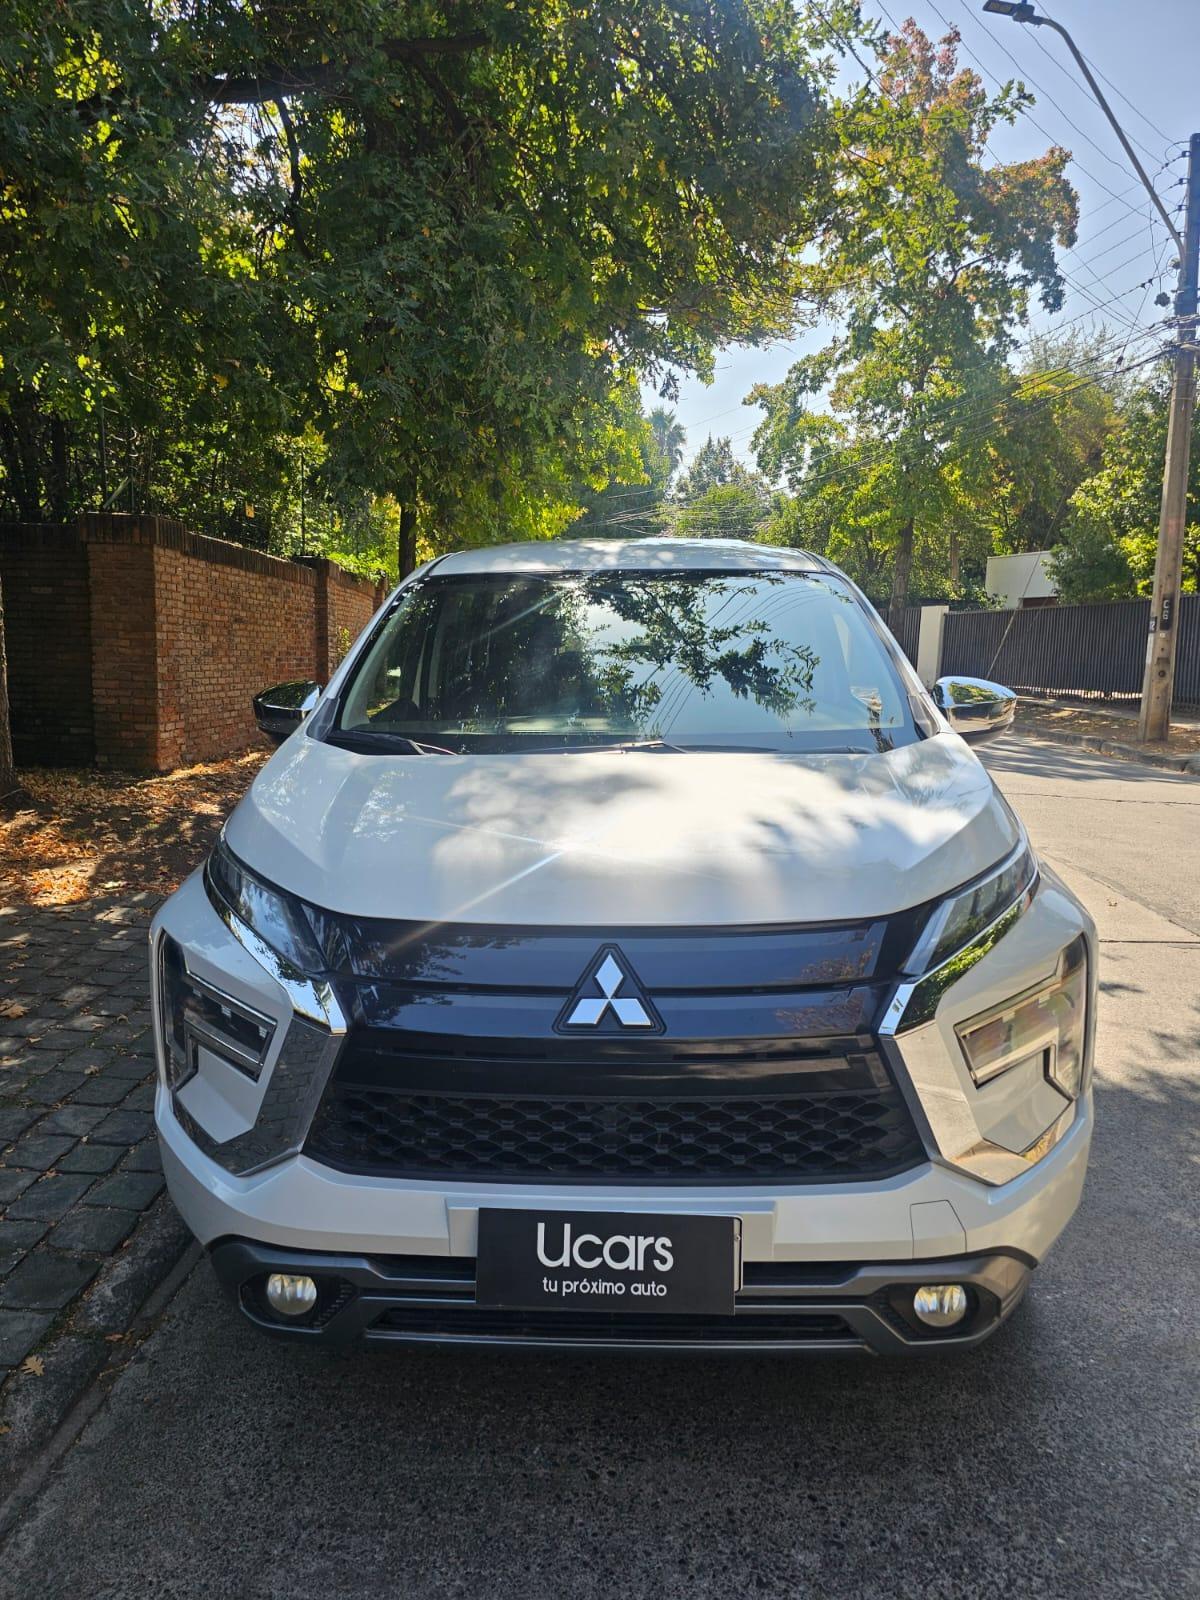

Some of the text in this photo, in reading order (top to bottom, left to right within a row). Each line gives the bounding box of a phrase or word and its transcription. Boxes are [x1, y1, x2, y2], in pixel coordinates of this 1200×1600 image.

[537, 1222, 674, 1272] Ucars
[542, 1276, 668, 1297] tu próximo auto
